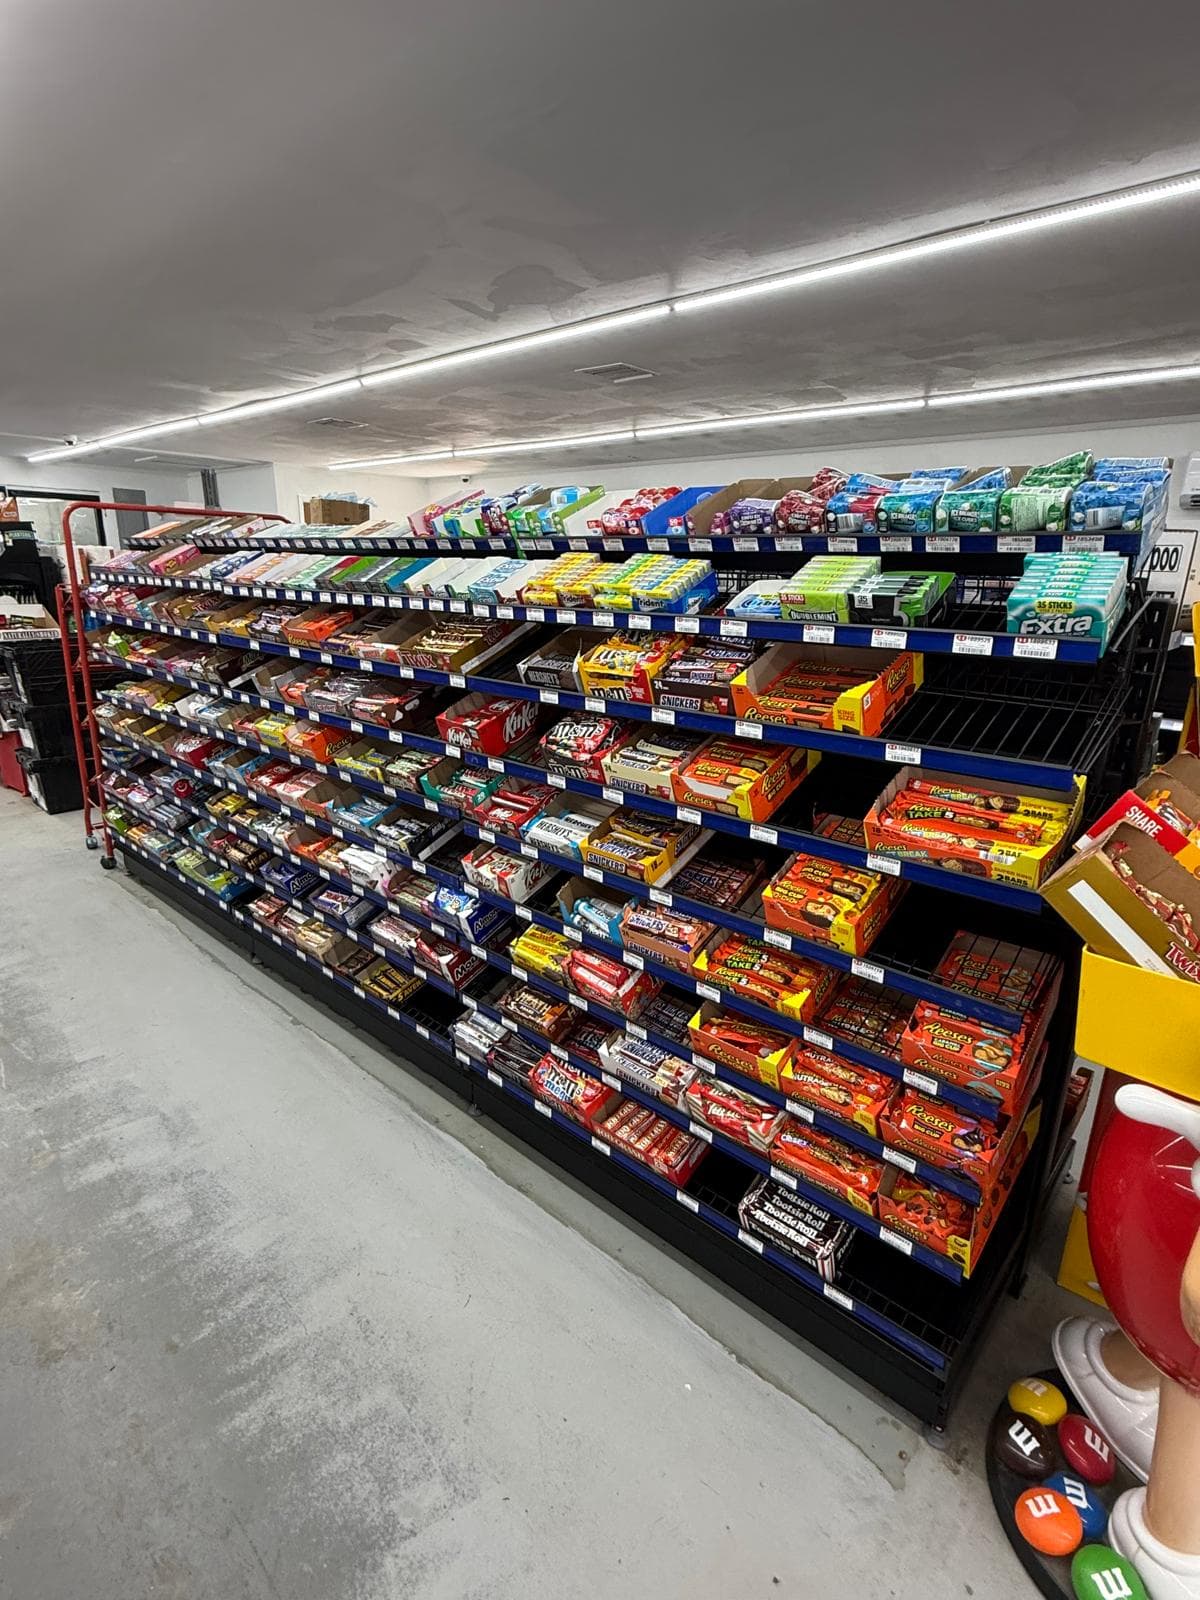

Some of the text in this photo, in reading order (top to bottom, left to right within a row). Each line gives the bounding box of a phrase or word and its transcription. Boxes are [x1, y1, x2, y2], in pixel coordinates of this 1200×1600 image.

[638, 597, 665, 608] Trident
[1037, 601, 1073, 610] 35 STICKS
[791, 611, 837, 622] DOUBLEMINT
[1020, 615, 1092, 636] Extra
[887, 658, 911, 692] Reese's
[661, 695, 700, 710] SNICKERS
[744, 707, 788, 724] Reese's
[611, 777, 646, 794] SNICKERS
[907, 810, 954, 819] TAKE 5
[1030, 810, 1054, 820] BARS
[1125, 806, 1164, 838] SHARE
[588, 853, 626, 872] SNICKERS
[1005, 876, 1028, 886] BARS
[726, 960, 752, 969] TAKE
[922, 1022, 974, 1044] Reese's
[906, 1104, 956, 1133] Reese's
[926, 1128, 940, 1139] CUP
[772, 1195, 826, 1230] Tootsie Roll
[778, 1186, 830, 1221] Tootsie Roll
[754, 1210, 808, 1247] Tootsie Roll
[763, 1201, 818, 1238] Tootsie Roll
[1024, 1494, 1062, 1518] m
[1091, 1568, 1133, 1600] m
